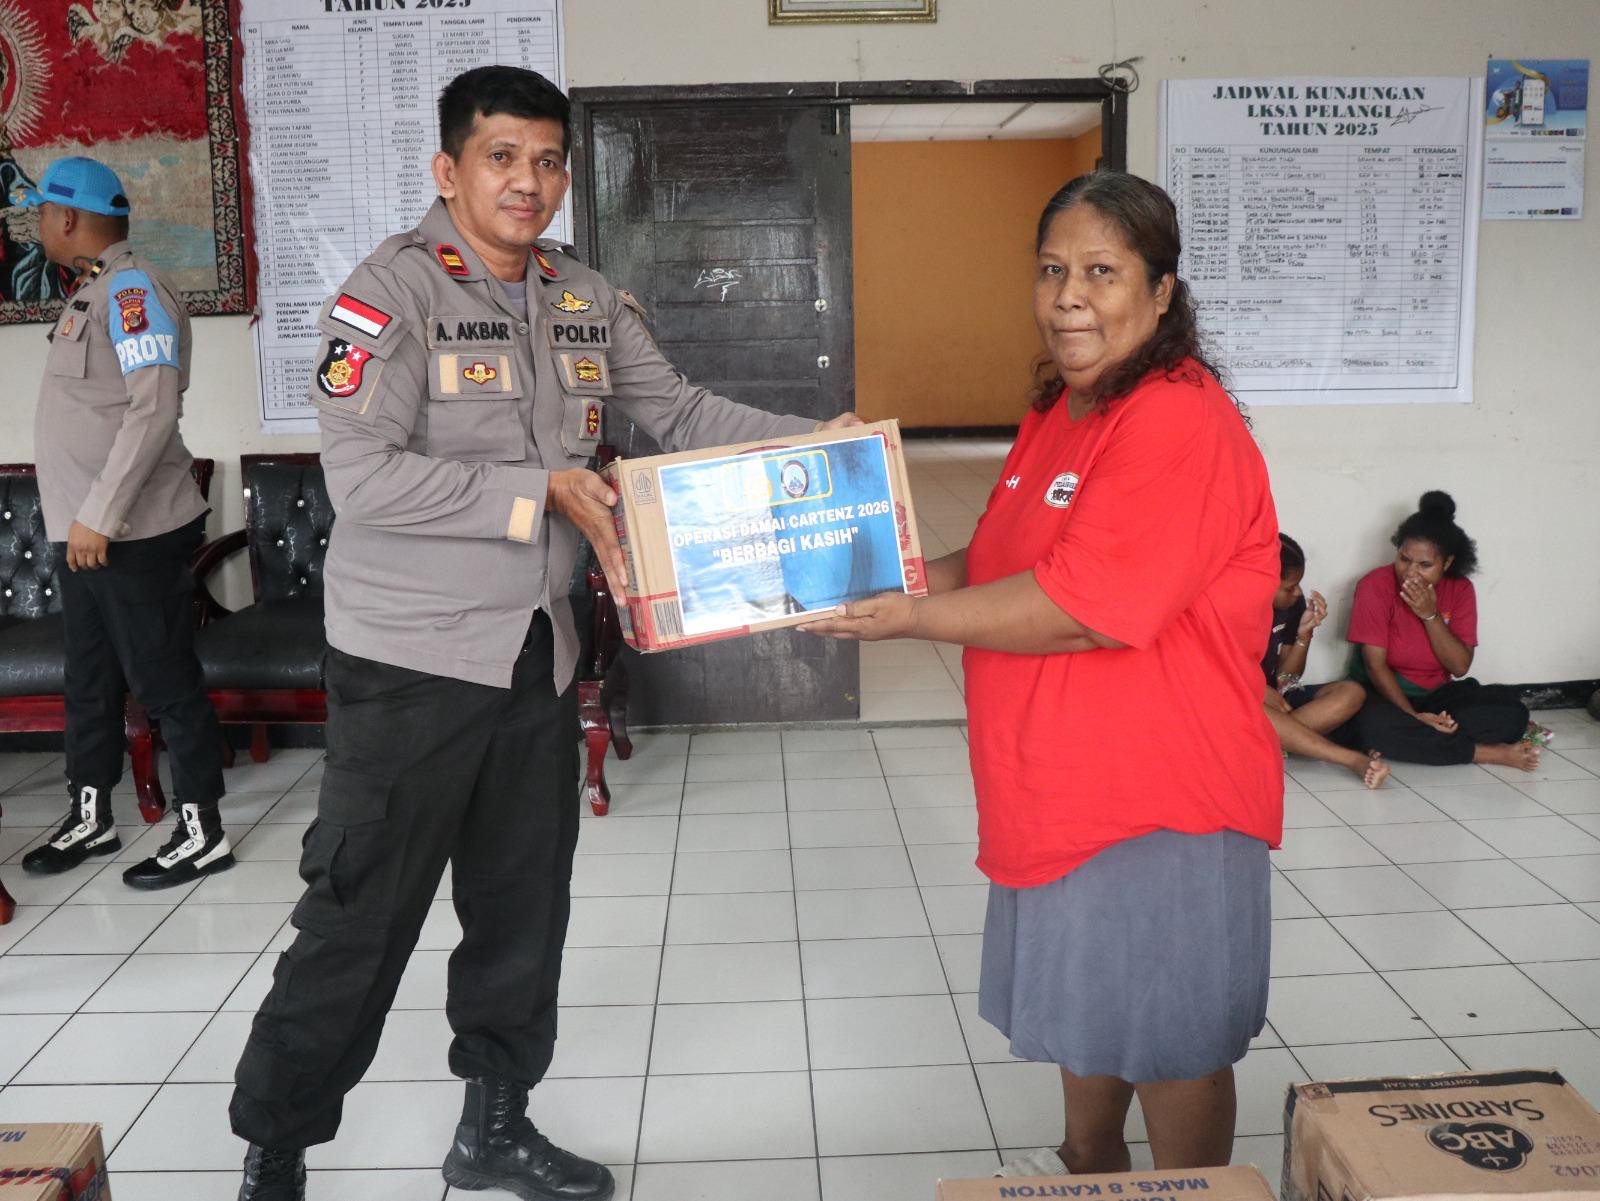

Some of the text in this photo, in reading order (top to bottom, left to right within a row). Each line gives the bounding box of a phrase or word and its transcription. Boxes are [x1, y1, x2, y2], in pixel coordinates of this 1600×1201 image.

[1212, 86, 1426, 100] JADWAL KUNJUNGAN
[1247, 105, 1298, 118] LKSA
[1304, 105, 1392, 119] PELANGI
[1260, 122, 1379, 136] TAHUN 2025
[118, 288, 145, 299] POLDA
[436, 322, 510, 341] A. AKBAR
[553, 324, 607, 343] POLRI
[115, 335, 173, 376] PROV
[673, 500, 890, 548] OPERASI DAMAI CARTENZ 2026
[713, 527, 859, 564] "BERBAGI KASIH"
[1430, 1078, 1480, 1088] CONTENT
[1437, 1129, 1516, 1151] ABC
[999, 1176, 1210, 1198] MAKS. 8 KARTON
